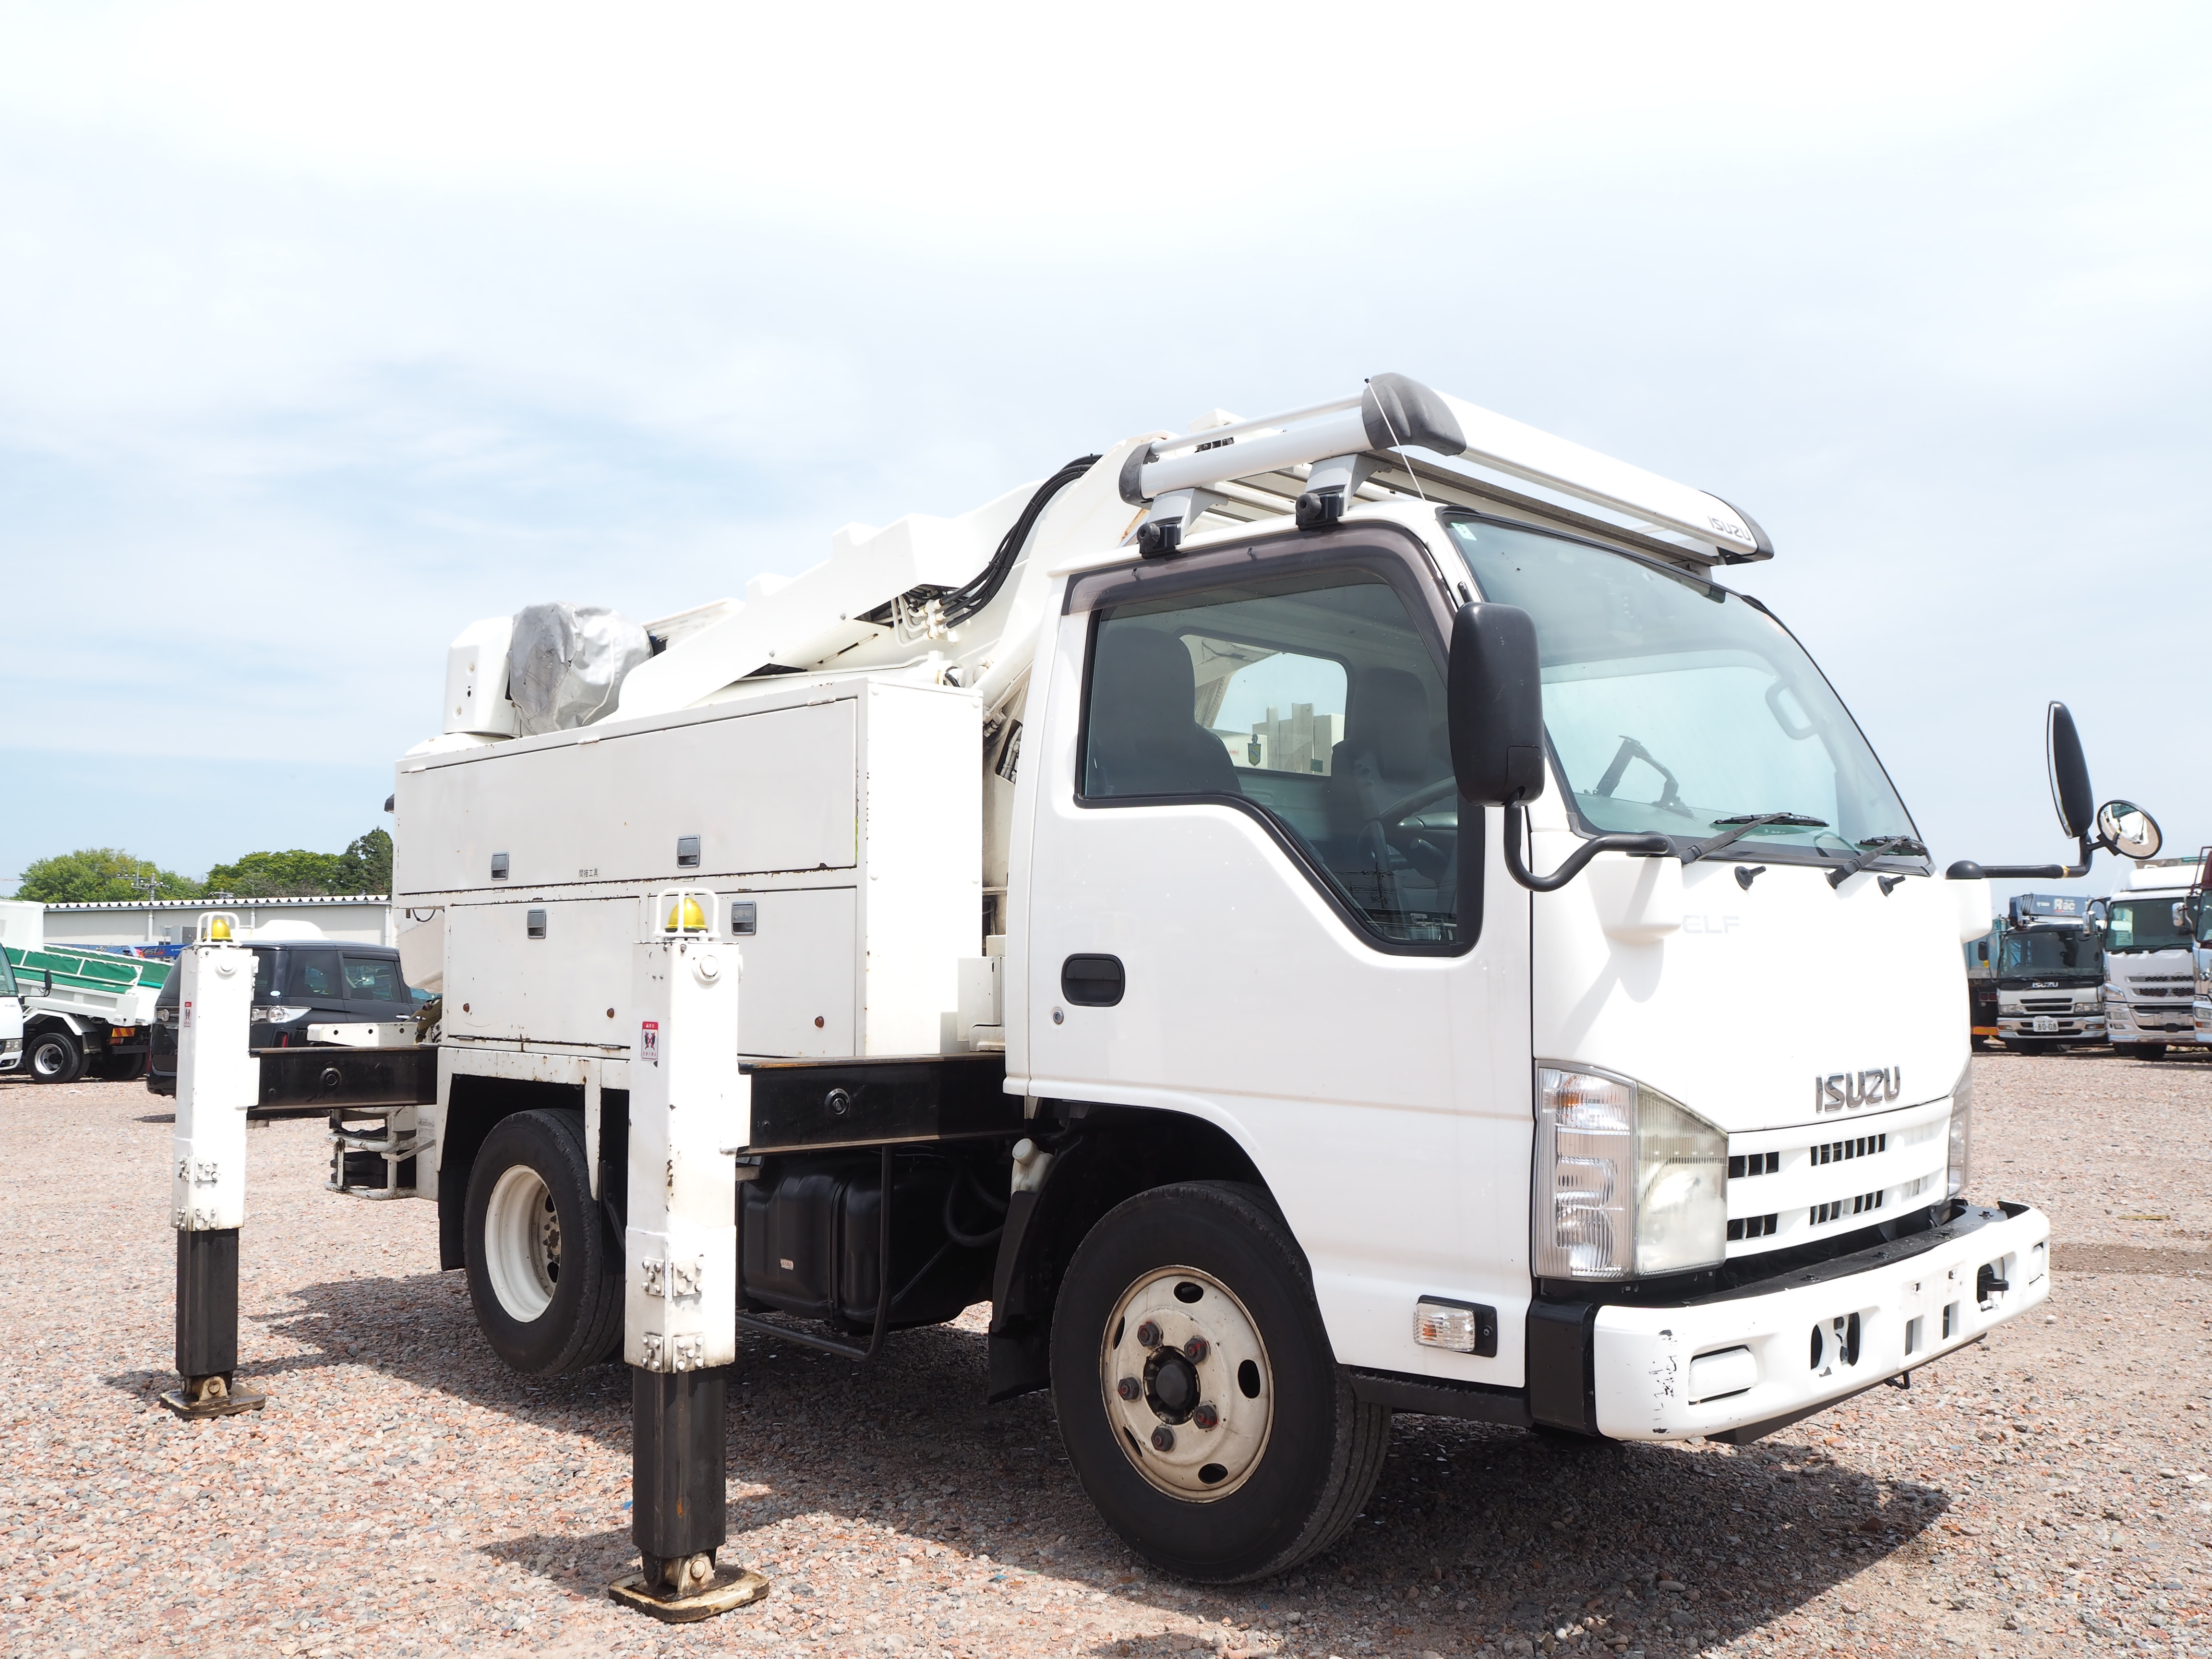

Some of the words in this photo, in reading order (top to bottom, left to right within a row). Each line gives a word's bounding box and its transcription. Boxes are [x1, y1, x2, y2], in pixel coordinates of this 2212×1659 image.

[1707, 516, 1751, 541] ISUZU
[1683, 914, 1740, 934] ELF
[1815, 1064, 1901, 1114] ISUZU
